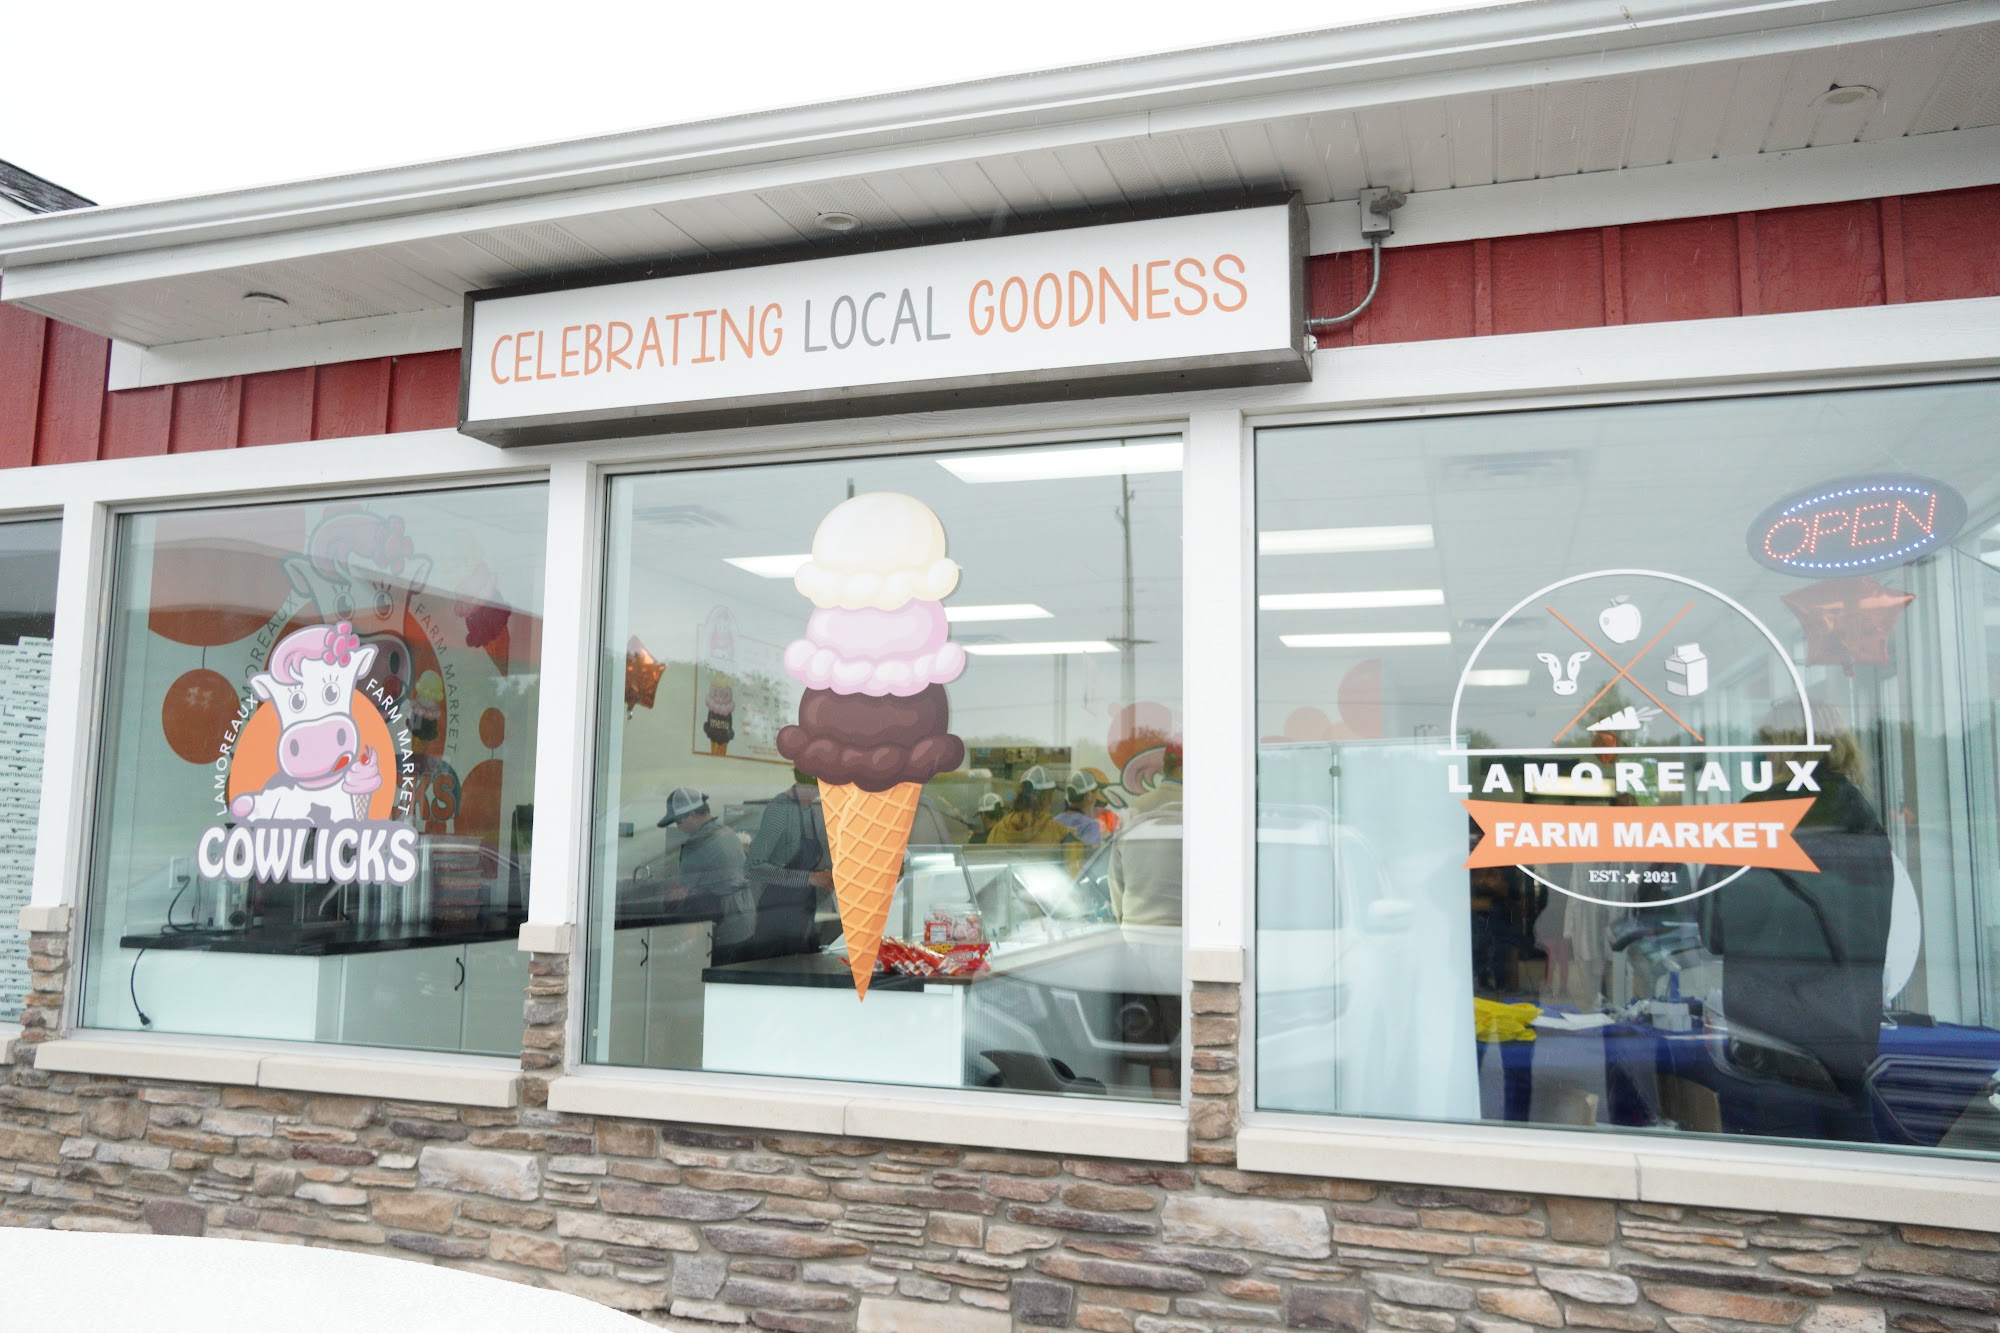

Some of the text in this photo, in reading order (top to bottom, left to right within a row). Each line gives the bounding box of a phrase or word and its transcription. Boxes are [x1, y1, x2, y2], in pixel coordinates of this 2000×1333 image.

[490, 253, 1248, 385] CELEBRATING LOCAL GOODNESS
[1764, 493, 1937, 559] OPEN
[415, 603, 459, 754] FARM MARKET
[214, 693, 259, 816] LAMOREAUX
[365, 679, 415, 816] FARM MARKET
[1448, 760, 1822, 794] LAMOREAUX
[196, 824, 418, 885] COWLICKS
[1494, 822, 1785, 849] FARM MARKET
[1588, 869, 1678, 885] EST. 2021
